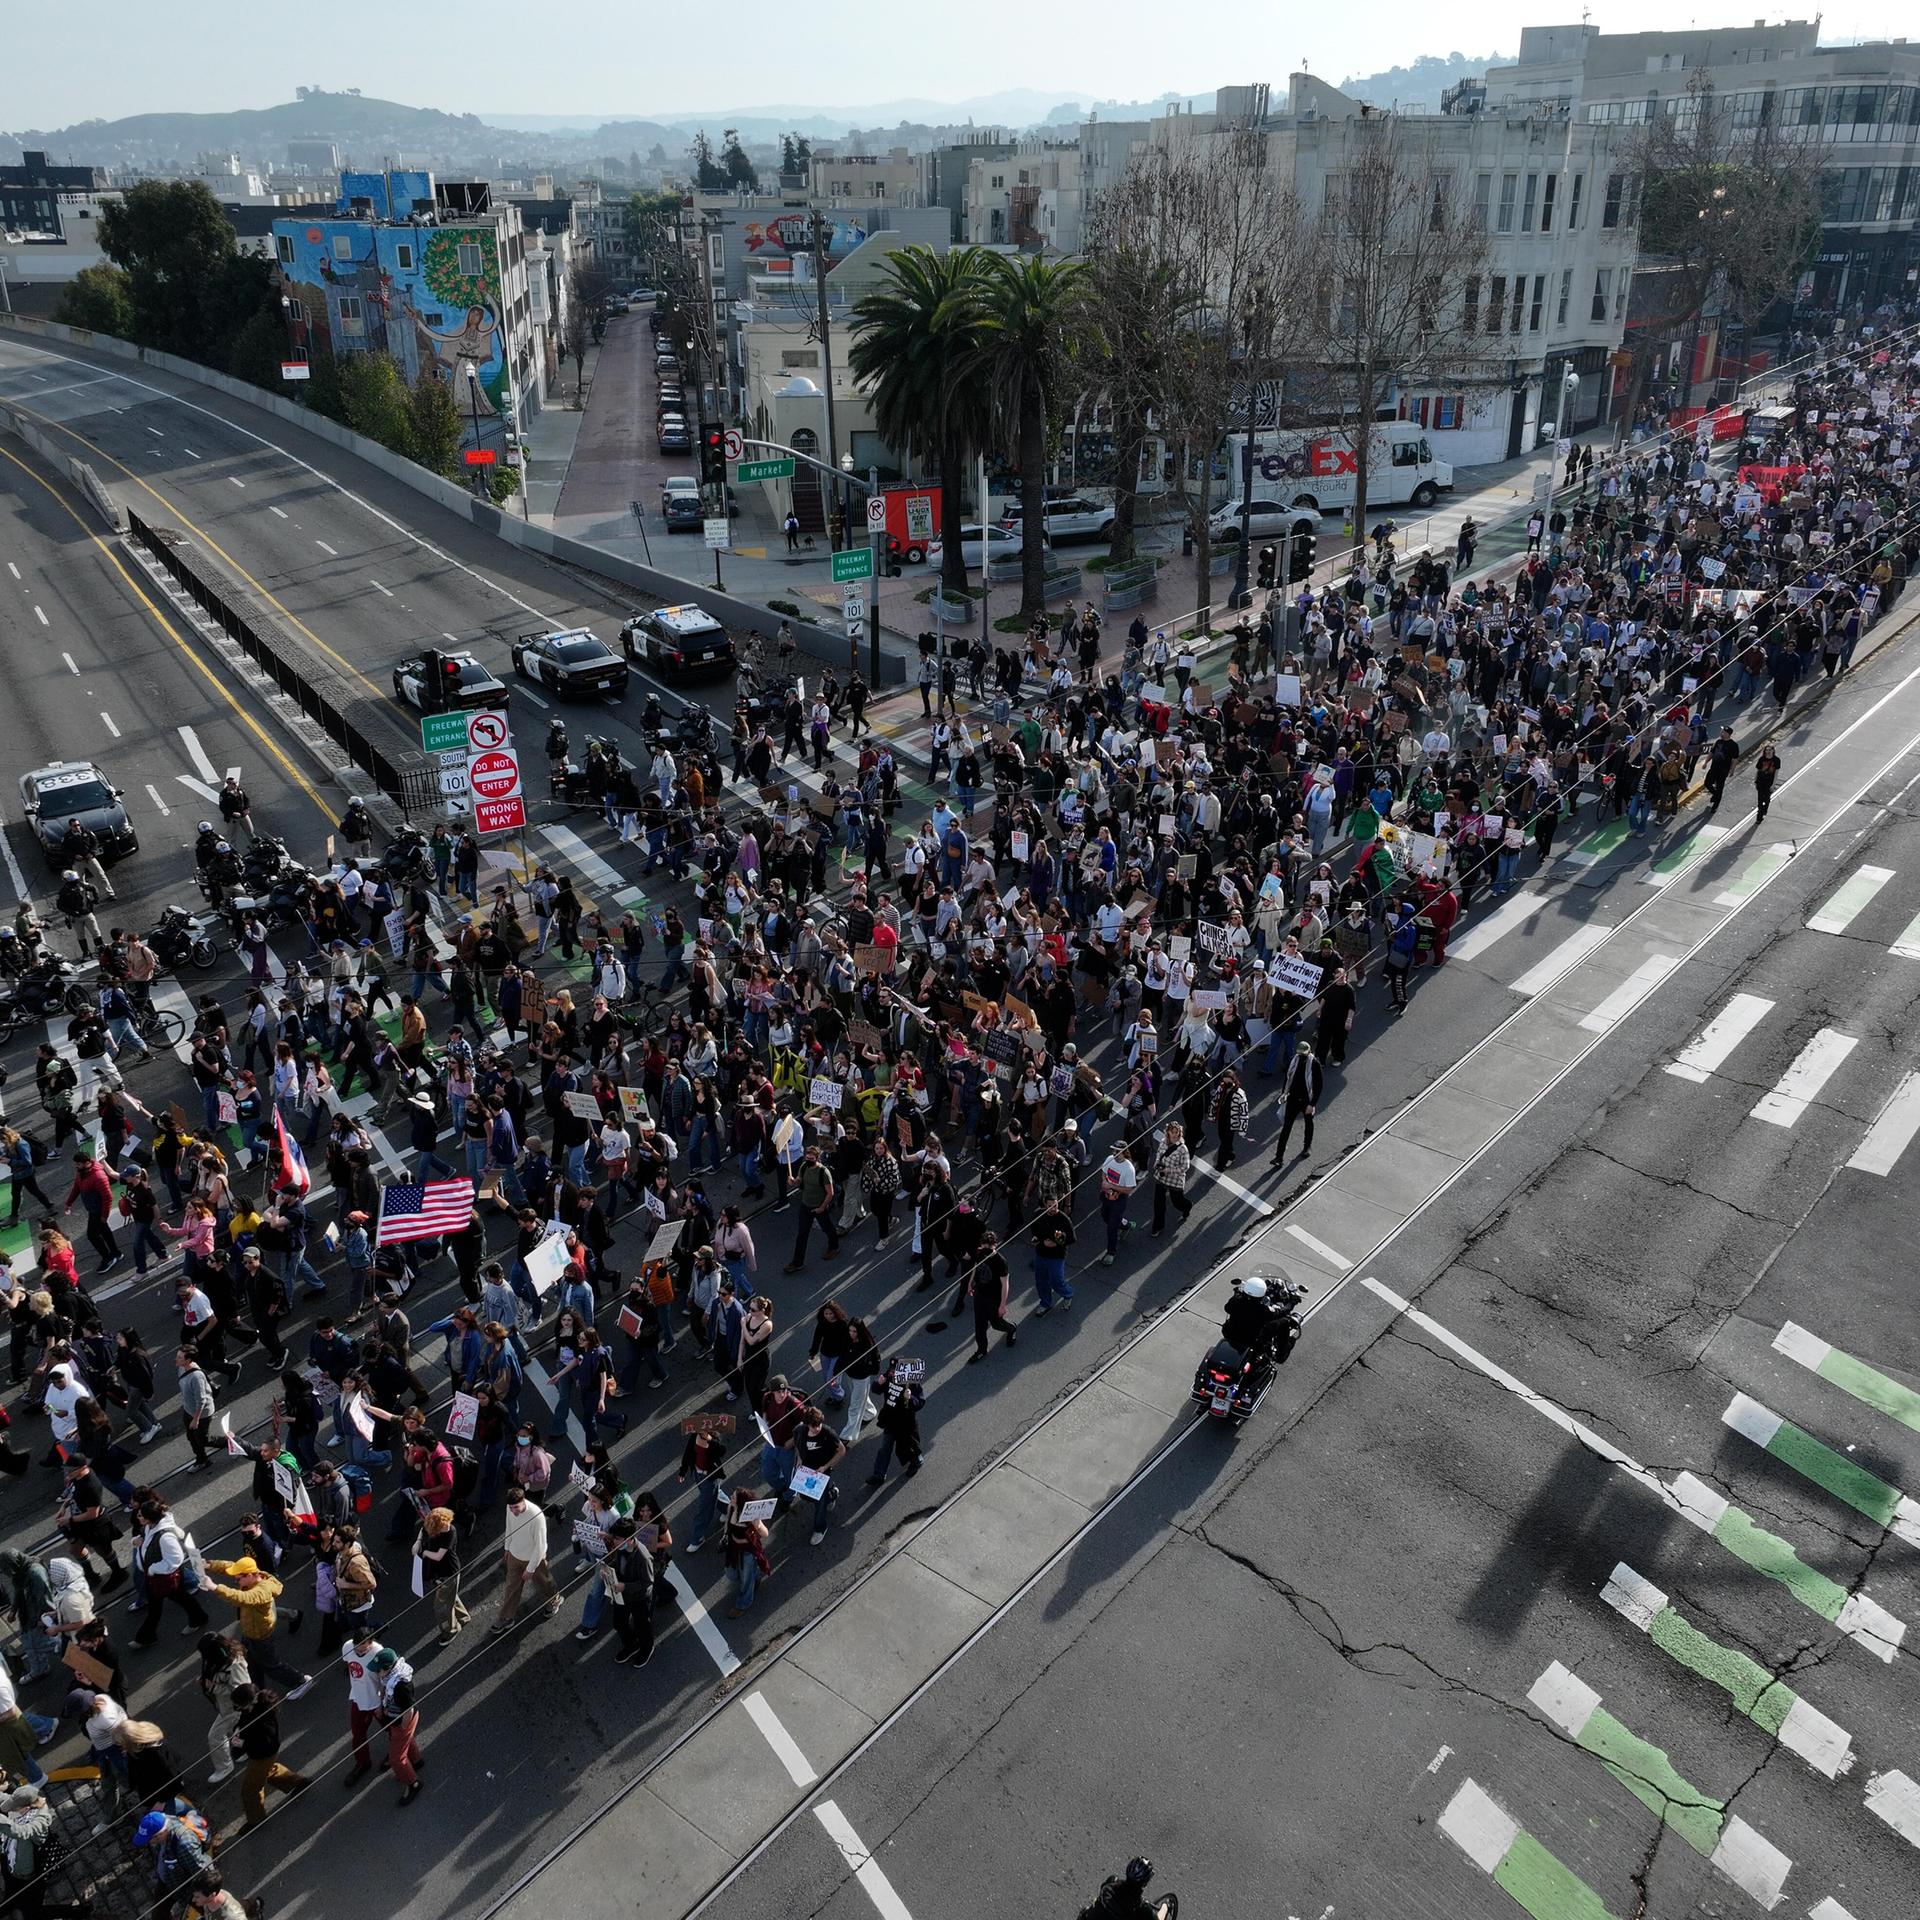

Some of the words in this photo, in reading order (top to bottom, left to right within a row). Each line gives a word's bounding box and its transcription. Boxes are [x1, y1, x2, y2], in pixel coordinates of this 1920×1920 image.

[1243, 438, 1358, 482] FedEx
[750, 464, 784, 477] Market
[1312, 483, 1347, 493] Ground
[877, 522, 885, 530] RED
[838, 555, 866, 565] FREEWAY
[1704, 558, 1725, 570] STOP
[837, 566, 869, 576] ENTRANCE
[844, 584, 862, 594] SOUTH
[1374, 585, 1385, 593] NO
[847, 604, 862, 616] 101
[431, 718, 467, 731] FREEWAY
[430, 732, 468, 744] ENTRANC
[442, 753, 465, 763] SOUTH
[476, 763, 488, 772] DO
[493, 759, 510, 768] NOT
[446, 776, 464, 790] 101
[482, 780, 510, 792] ENTER
[481, 802, 518, 816] WRONG
[489, 814, 512, 826] WAY
[1200, 922, 1228, 942] CHINGA
[1202, 934, 1212, 950] LA
[1274, 954, 1312, 977] Migration
[1312, 970, 1322, 980] is
[522, 976, 544, 992] FUCK
[1276, 971, 1299, 986] human
[1299, 980, 1318, 994] right
[521, 989, 544, 1012] ICE
[812, 1080, 842, 1094] ABOLISH
[812, 1092, 840, 1106] BORDERS
[896, 1362, 910, 1372] ICE
[910, 1360, 924, 1372] OUT
[907, 1372, 925, 1381] GOOD
